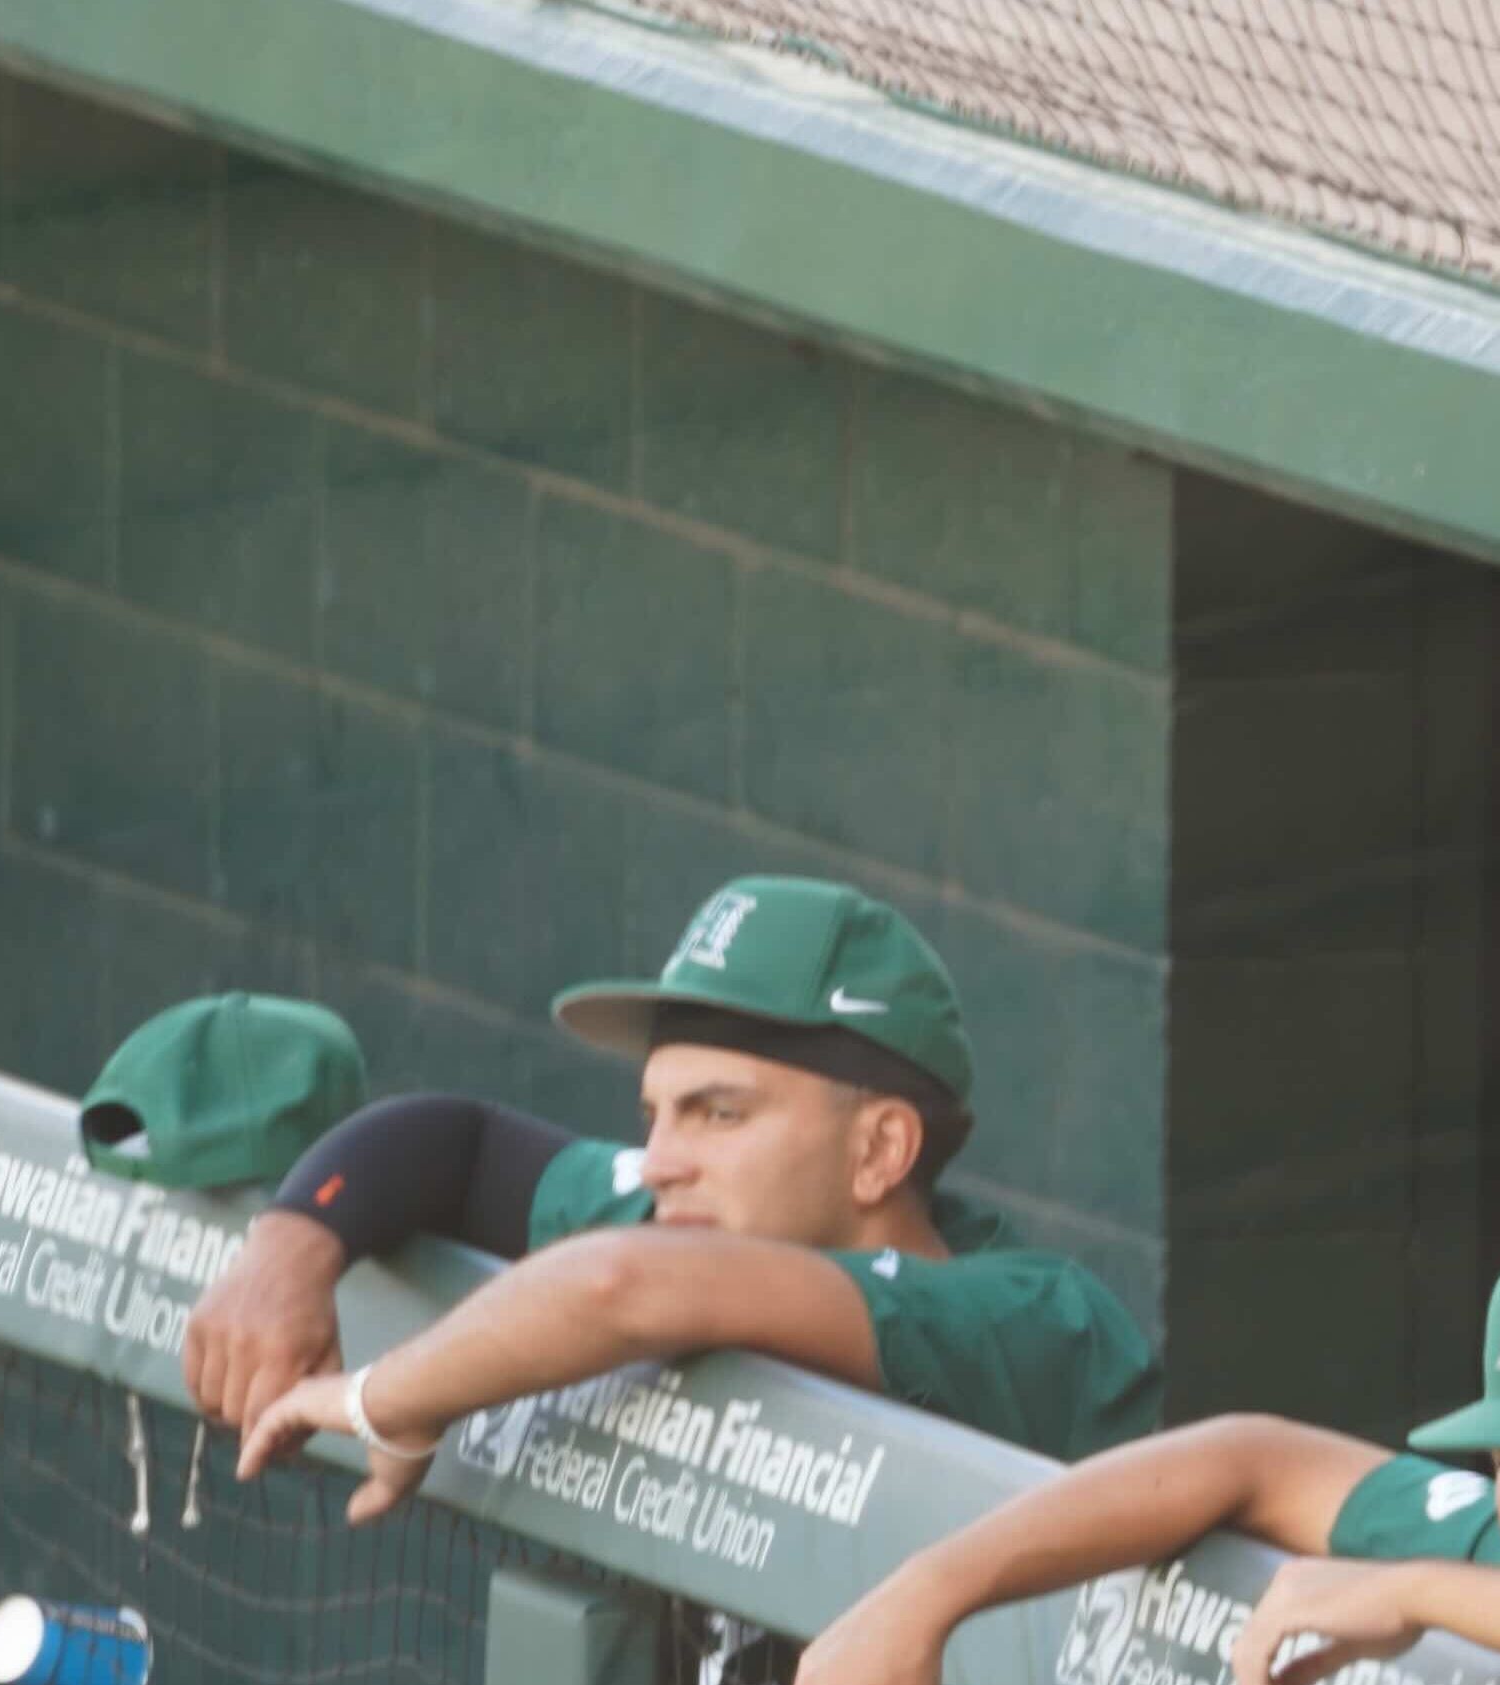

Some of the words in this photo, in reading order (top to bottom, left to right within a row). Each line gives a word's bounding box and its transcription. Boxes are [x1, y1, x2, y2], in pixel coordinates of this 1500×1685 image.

[25, 1239, 107, 1324] Credit
[105, 1265, 191, 1355] Union
[516, 1419, 622, 1512] Federal
[614, 1455, 699, 1544] Credit
[691, 1484, 776, 1572] Union
[706, 1399, 886, 1527] Financial
